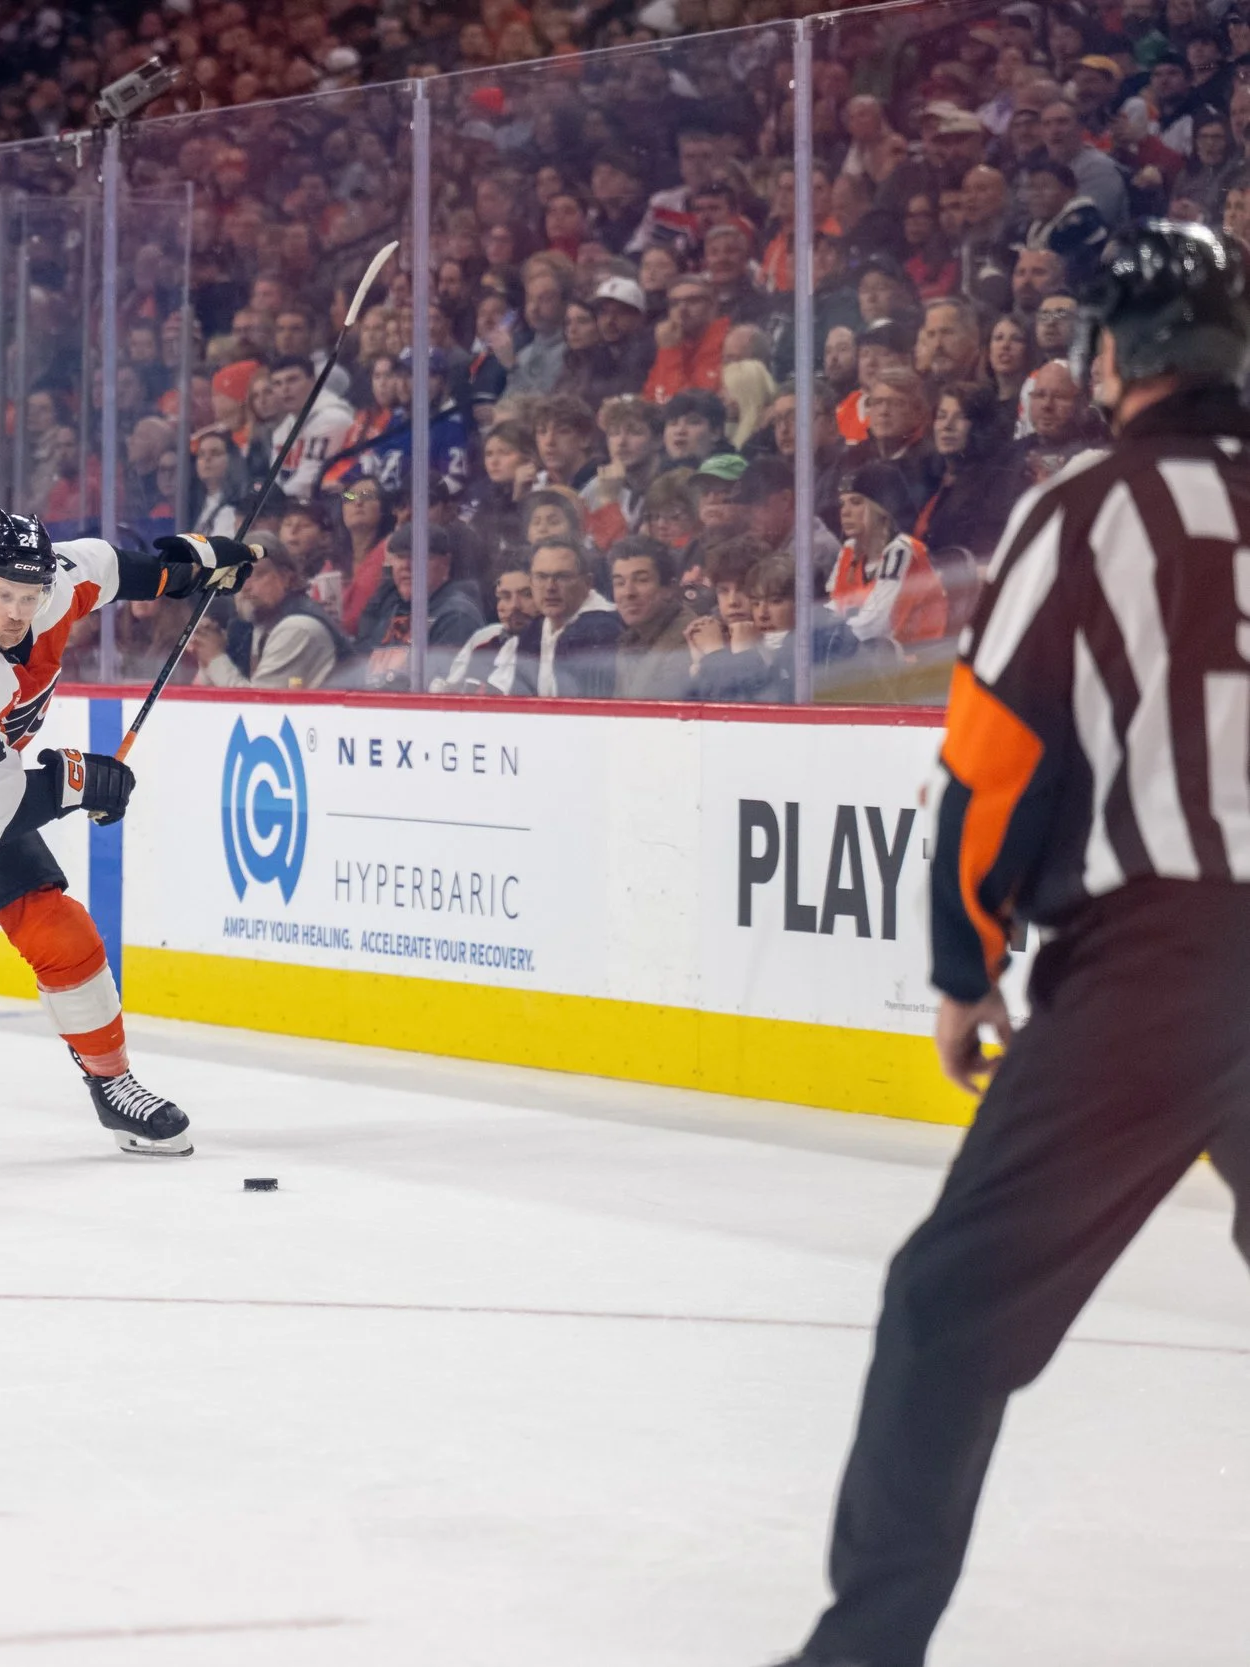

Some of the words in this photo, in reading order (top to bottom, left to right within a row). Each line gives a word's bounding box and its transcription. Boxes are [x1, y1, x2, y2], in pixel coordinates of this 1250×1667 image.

[14, 563, 41, 572] CCM
[19, 531, 38, 549] 24
[333, 859, 520, 920] HYPERBARIC
[737, 798, 917, 941] PLAY
[223, 916, 267, 940] AMPLIFY
[268, 921, 299, 945] YOUR
[301, 924, 353, 950] HEALING.
[360, 930, 432, 960] ACCELERATE
[433, 937, 467, 964] YOUR
[469, 942, 536, 972] RECOVERY.
